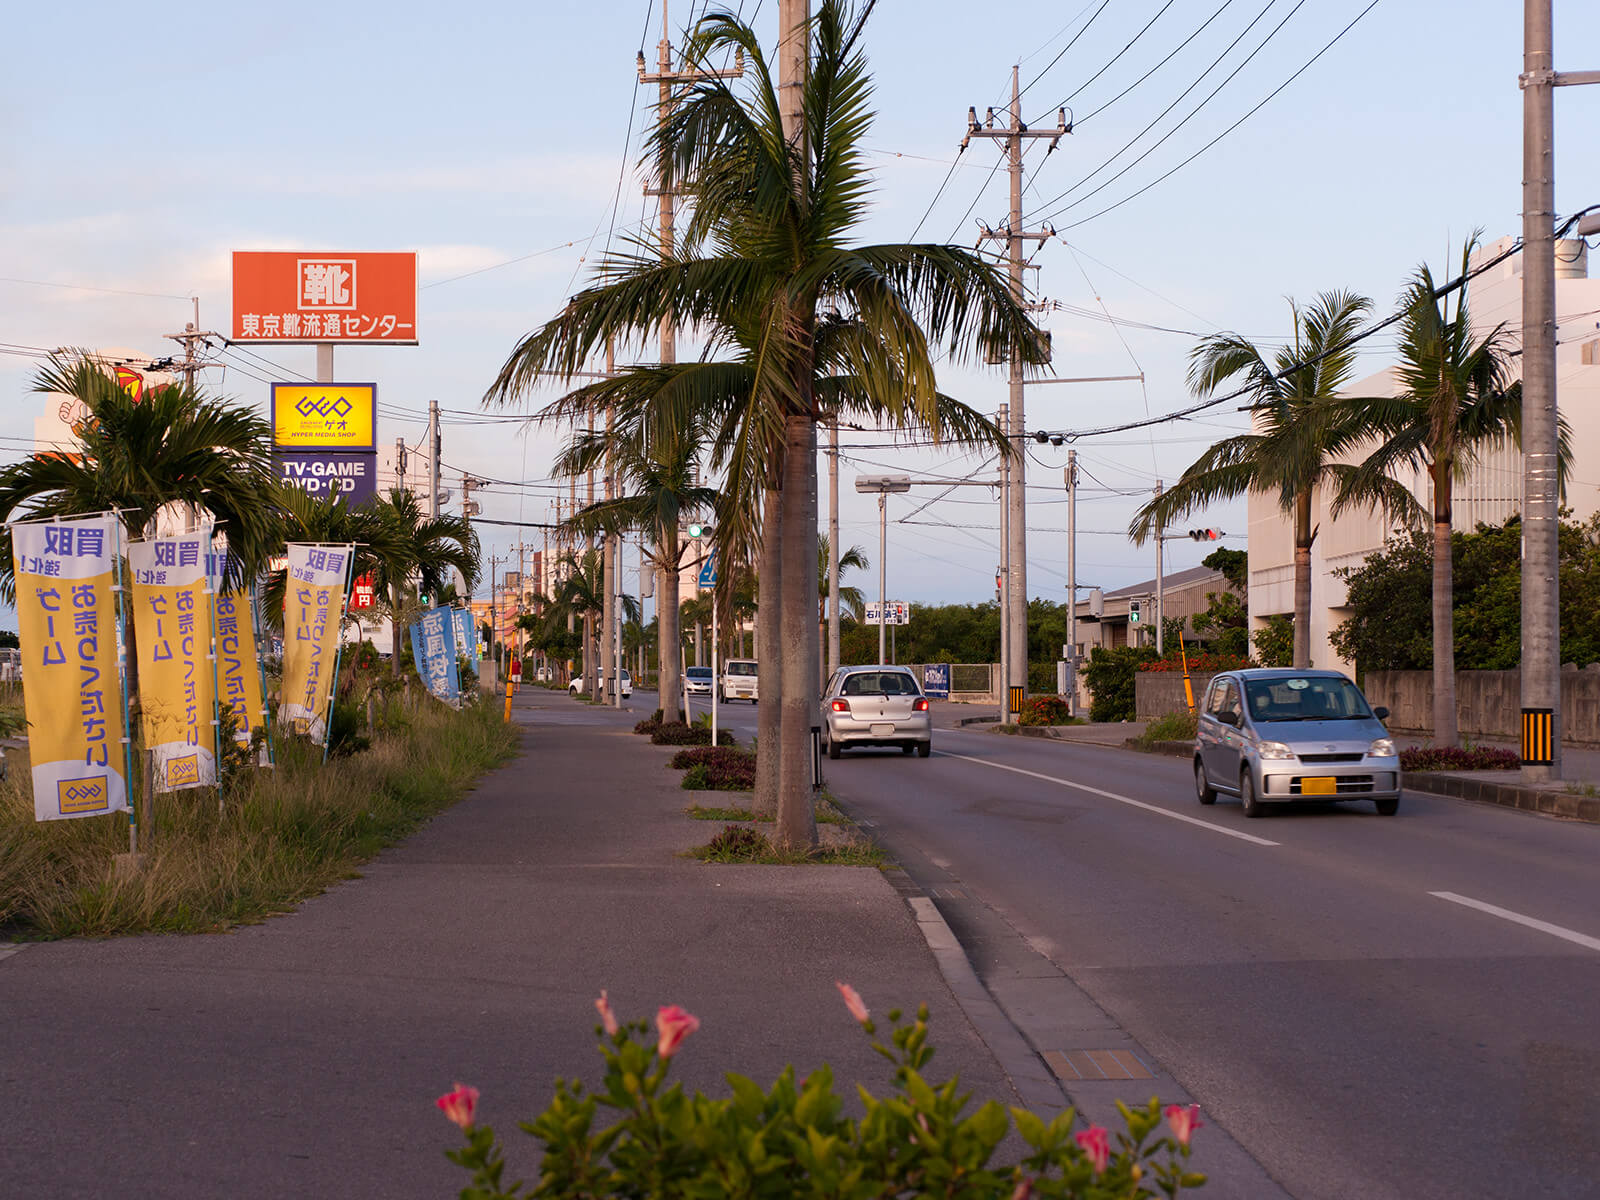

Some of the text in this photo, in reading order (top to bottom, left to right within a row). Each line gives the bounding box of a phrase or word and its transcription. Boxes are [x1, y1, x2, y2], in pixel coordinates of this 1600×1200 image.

[303, 264, 350, 305] 靴
[241, 313, 413, 337] 東京靴流通センター
[324, 420, 348, 430] ゲオ
[283, 462, 365, 476] TV-GAME
